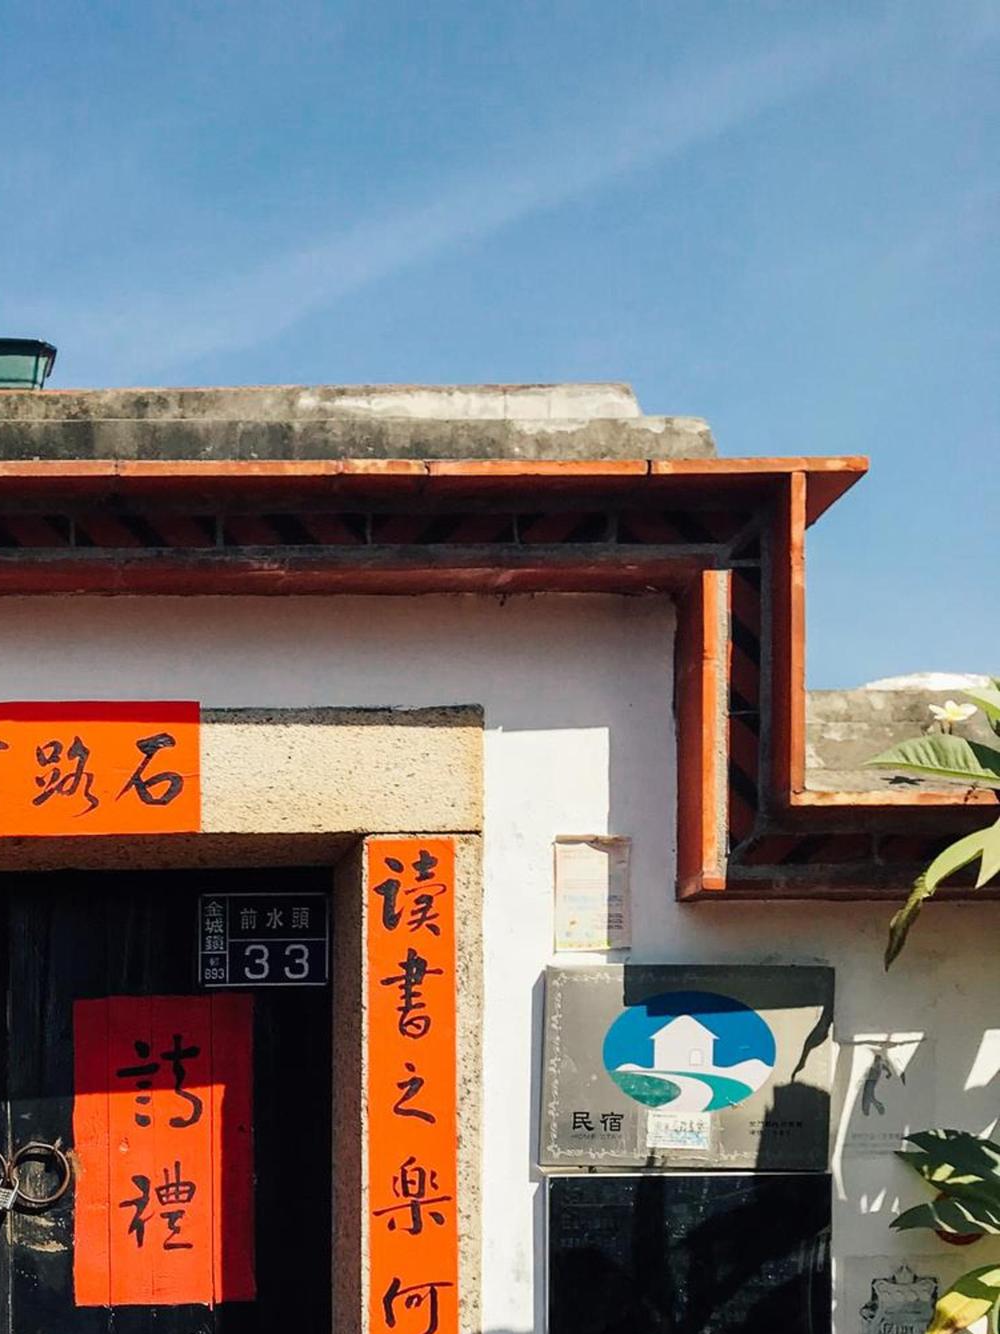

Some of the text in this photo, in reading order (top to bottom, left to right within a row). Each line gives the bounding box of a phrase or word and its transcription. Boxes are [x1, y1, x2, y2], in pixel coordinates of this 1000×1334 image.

[239, 906, 311, 930] 前水頭
[243, 943, 311, 980] 33
[571, 1111, 625, 1132] 民宿
[115, 1034, 204, 1251] 詩禮
